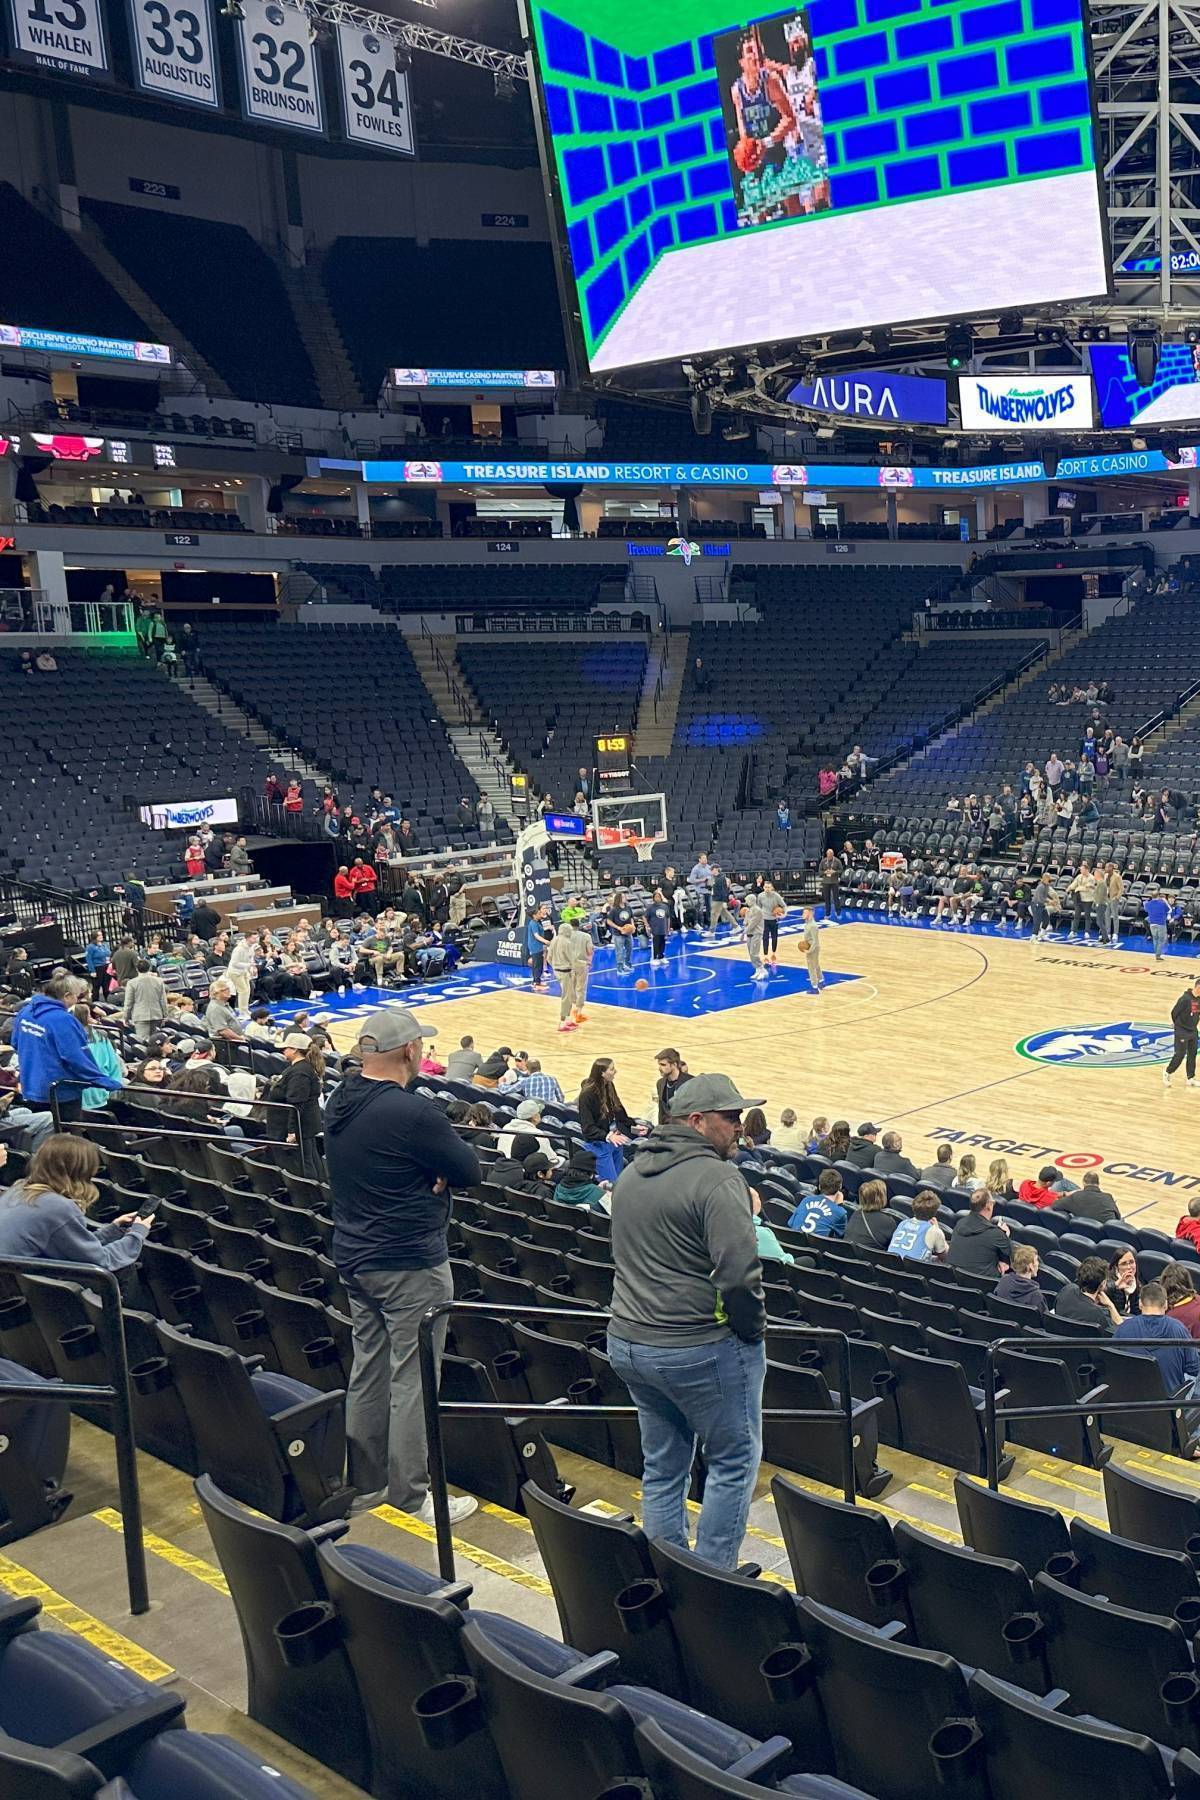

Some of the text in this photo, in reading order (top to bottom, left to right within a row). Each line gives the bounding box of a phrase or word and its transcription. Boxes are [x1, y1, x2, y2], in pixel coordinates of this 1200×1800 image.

[28, 26, 93, 56] WHALEN
[144, 1, 204, 64] 33
[36, 56, 90, 76] HALL OF FAME
[252, 32, 309, 93] 32
[145, 57, 211, 89] AUGUSTUS
[349, 60, 404, 117] 34
[252, 87, 315, 115] BRUNSON
[357, 113, 402, 137] FOWLES
[143, 182, 167, 197] 223
[494, 214, 516, 227] 224
[20, 331, 134, 350] EXCLUSIVE CASINO PARTNER
[32, 339, 46, 347] THE
[427, 371, 523, 380] EXCLUSIVE CASINO PARTNER
[813, 377, 899, 418] AURA
[976, 382, 1075, 423] TIMBERWOLVES
[463, 465, 749, 481] TREASURE ISLAND RESORT & CASINO
[932, 468, 998, 484] TREASURE
[999, 464, 1041, 481] ISLAND
[1091, 459, 1100, 473] &
[1102, 454, 1148, 472] CASINO
[174, 535, 192, 545] 122
[495, 542, 512, 551] 124
[165, 804, 214, 824] TIMBERWOLVES
[497, 949, 522, 959] CENTER
[498, 941, 523, 950] TARGET
[1035, 956, 1123, 971] TARGET
[923, 1126, 1064, 1160] TARGET
[801, 1212, 820, 1232] 5
[891, 1230, 917, 1251] 23
